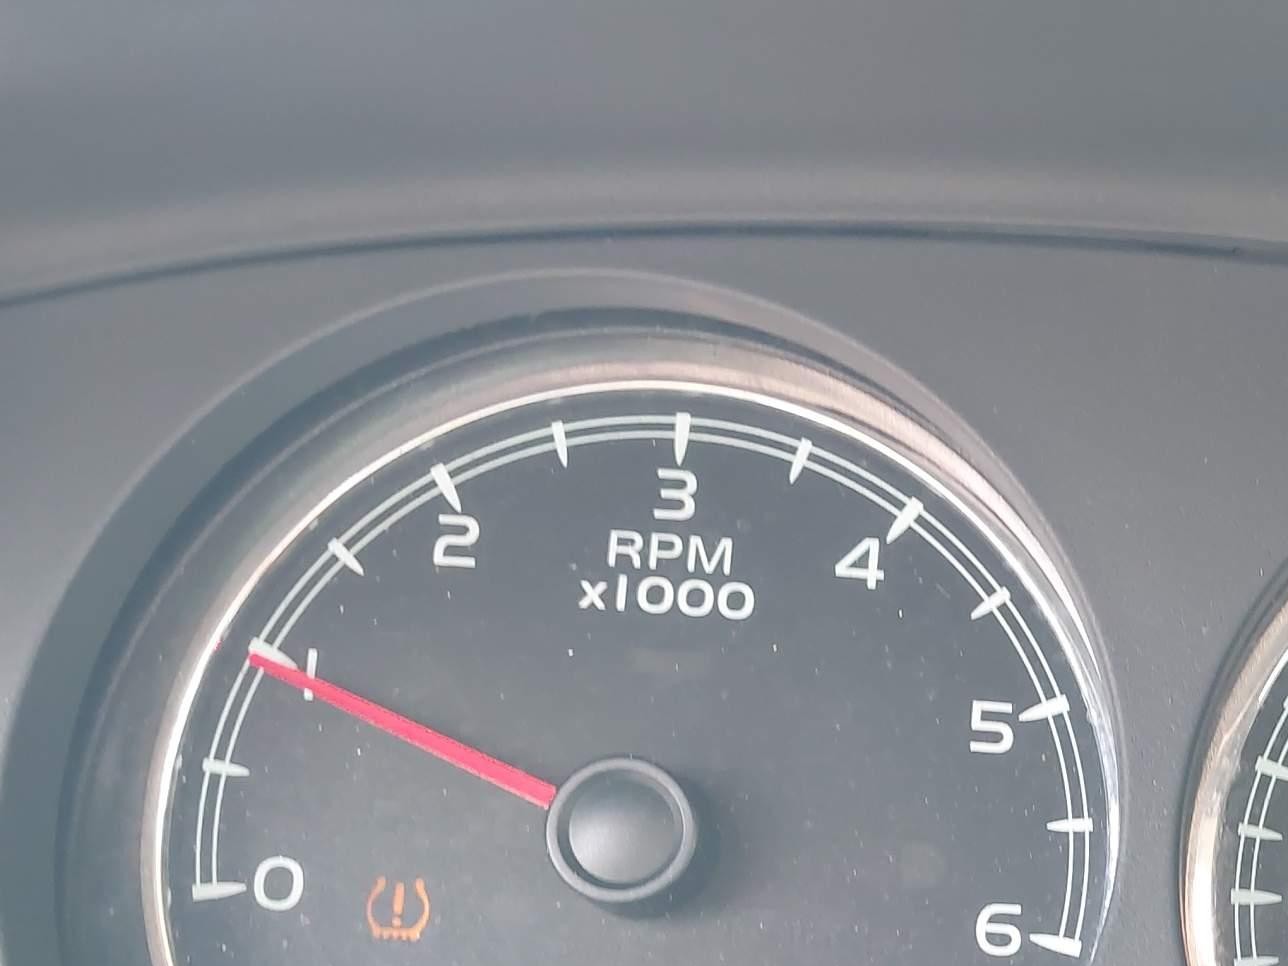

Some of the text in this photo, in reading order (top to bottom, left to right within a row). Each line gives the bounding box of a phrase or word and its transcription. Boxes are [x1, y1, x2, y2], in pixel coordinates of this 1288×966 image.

[653, 468, 698, 520] 3
[433, 514, 480, 569] 2
[607, 529, 733, 577] RPM
[834, 537, 884, 589] 4
[578, 573, 755, 620] x1000
[969, 700, 1014, 754] 5
[253, 856, 304, 911] 0
[975, 903, 1022, 957] 6
